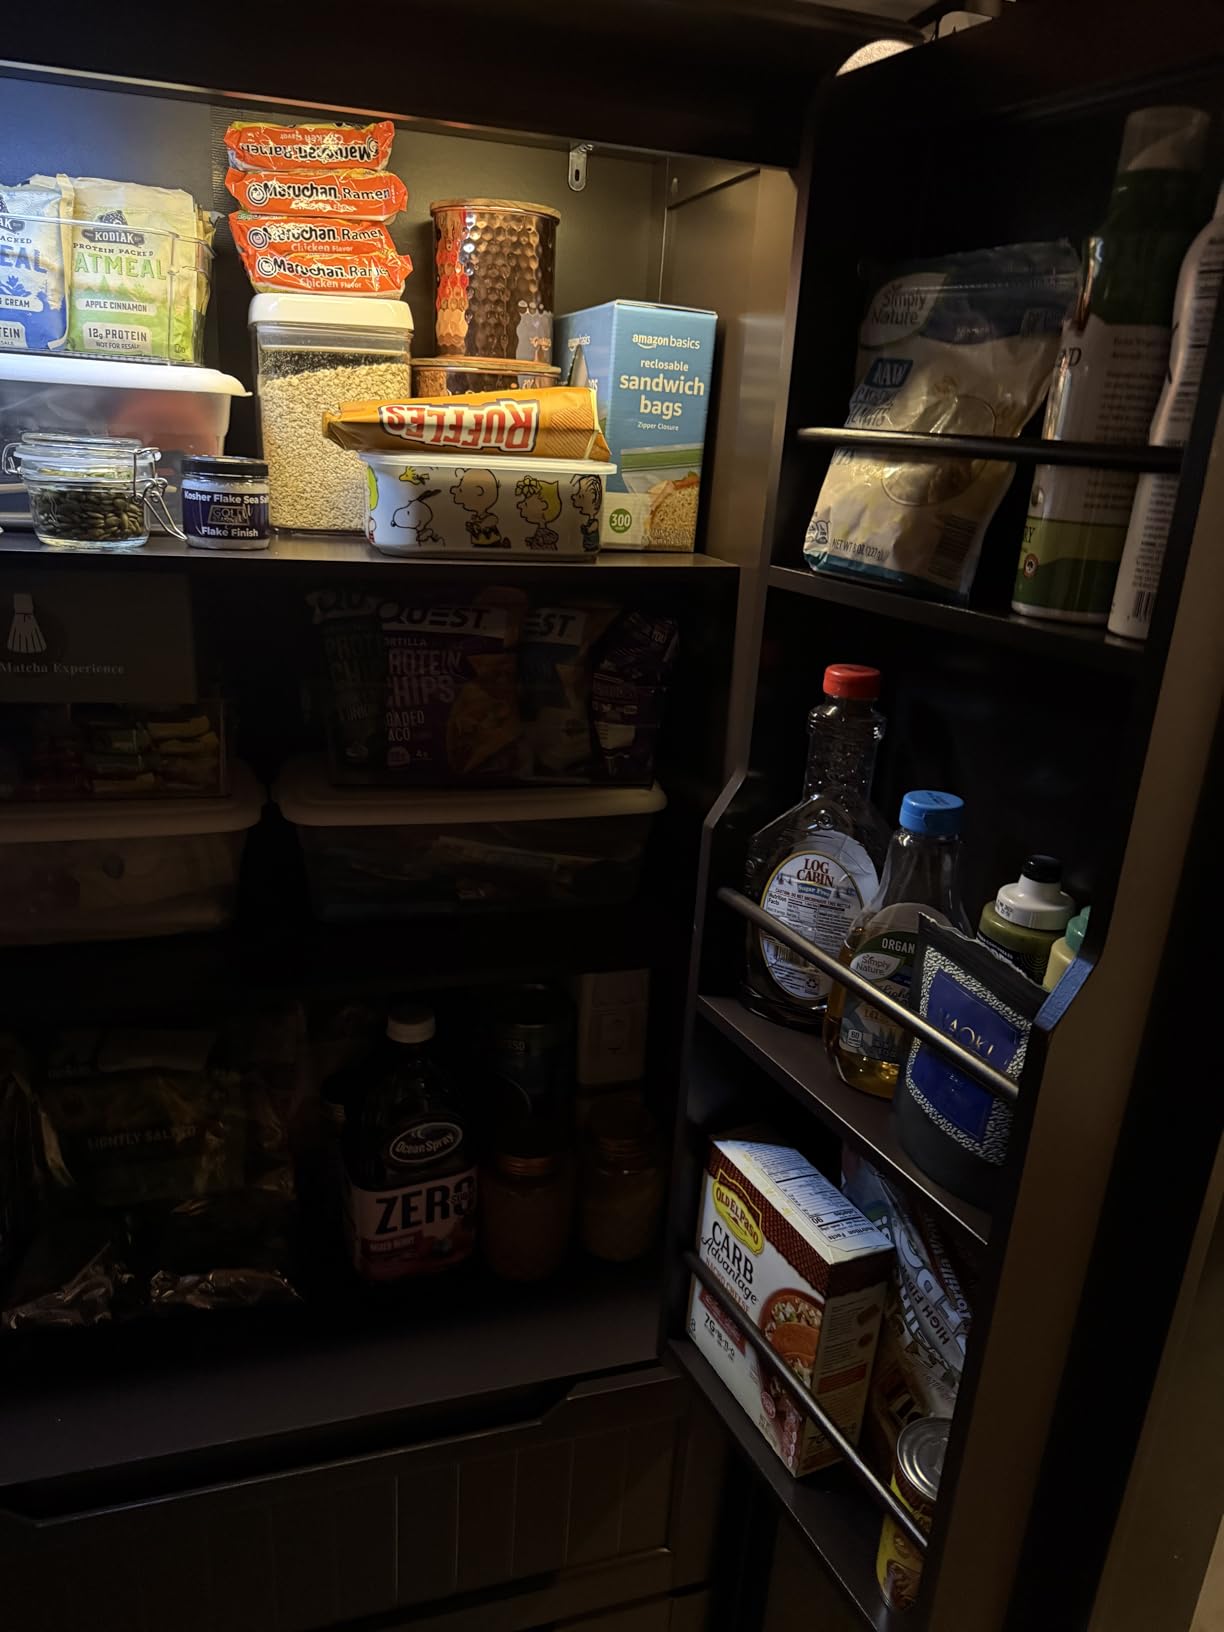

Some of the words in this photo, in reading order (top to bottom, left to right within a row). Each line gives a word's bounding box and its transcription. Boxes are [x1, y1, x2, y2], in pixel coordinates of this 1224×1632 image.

[241, 143, 294, 159] Ramen
[94, 230, 135, 245] KODIAK
[73, 242, 115, 254] PROTEIN
[291, 242, 330, 253] Chicken
[74, 252, 167, 281] ATMEAL
[273, 258, 344, 278] Maruchan
[5, 298, 30, 307] CREAM
[85, 300, 109, 309] APPLE
[109, 301, 148, 313] CINNAMON
[872, 307, 920, 325] Nature
[105, 329, 147, 342] PROTEIN
[640, 359, 689, 372] reclosable
[619, 373, 705, 396] sandwich
[639, 396, 682, 419] bags
[385, 403, 535, 450] RUFFLES
[637, 421, 656, 431] Zipper
[657, 423, 679, 432] Closure
[184, 490, 212, 502] Kosher
[213, 493, 242, 503] Flake
[243, 495, 259, 504] Sea
[611, 513, 631, 527] 300
[201, 526, 229, 537] Flake
[231, 527, 259, 537] Finish
[379, 602, 490, 629] QUEST
[524, 608, 576, 632] EST
[388, 648, 461, 674] ROTEIN
[53, 662, 125, 680] Experience
[385, 709, 425, 728] OADED
[388, 728, 411, 742] ACO
[804, 858, 830, 874] LOG
[796, 869, 834, 887] CABIN
[881, 937, 916, 954] ORGAN
[856, 962, 885, 976] Nature
[861, 954, 890, 970] Simply
[395, 1140, 426, 1155] Ocean
[425, 1131, 455, 1152] Spray
[375, 1175, 475, 1235] ZERO
[715, 1187, 730, 1207] OLD
[730, 1199, 741, 1218] EL
[740, 1209, 759, 1245] PASO
[712, 1220, 754, 1285] CARB
[701, 1236, 758, 1305] Advantage
[922, 1305, 950, 1345] HIGH
